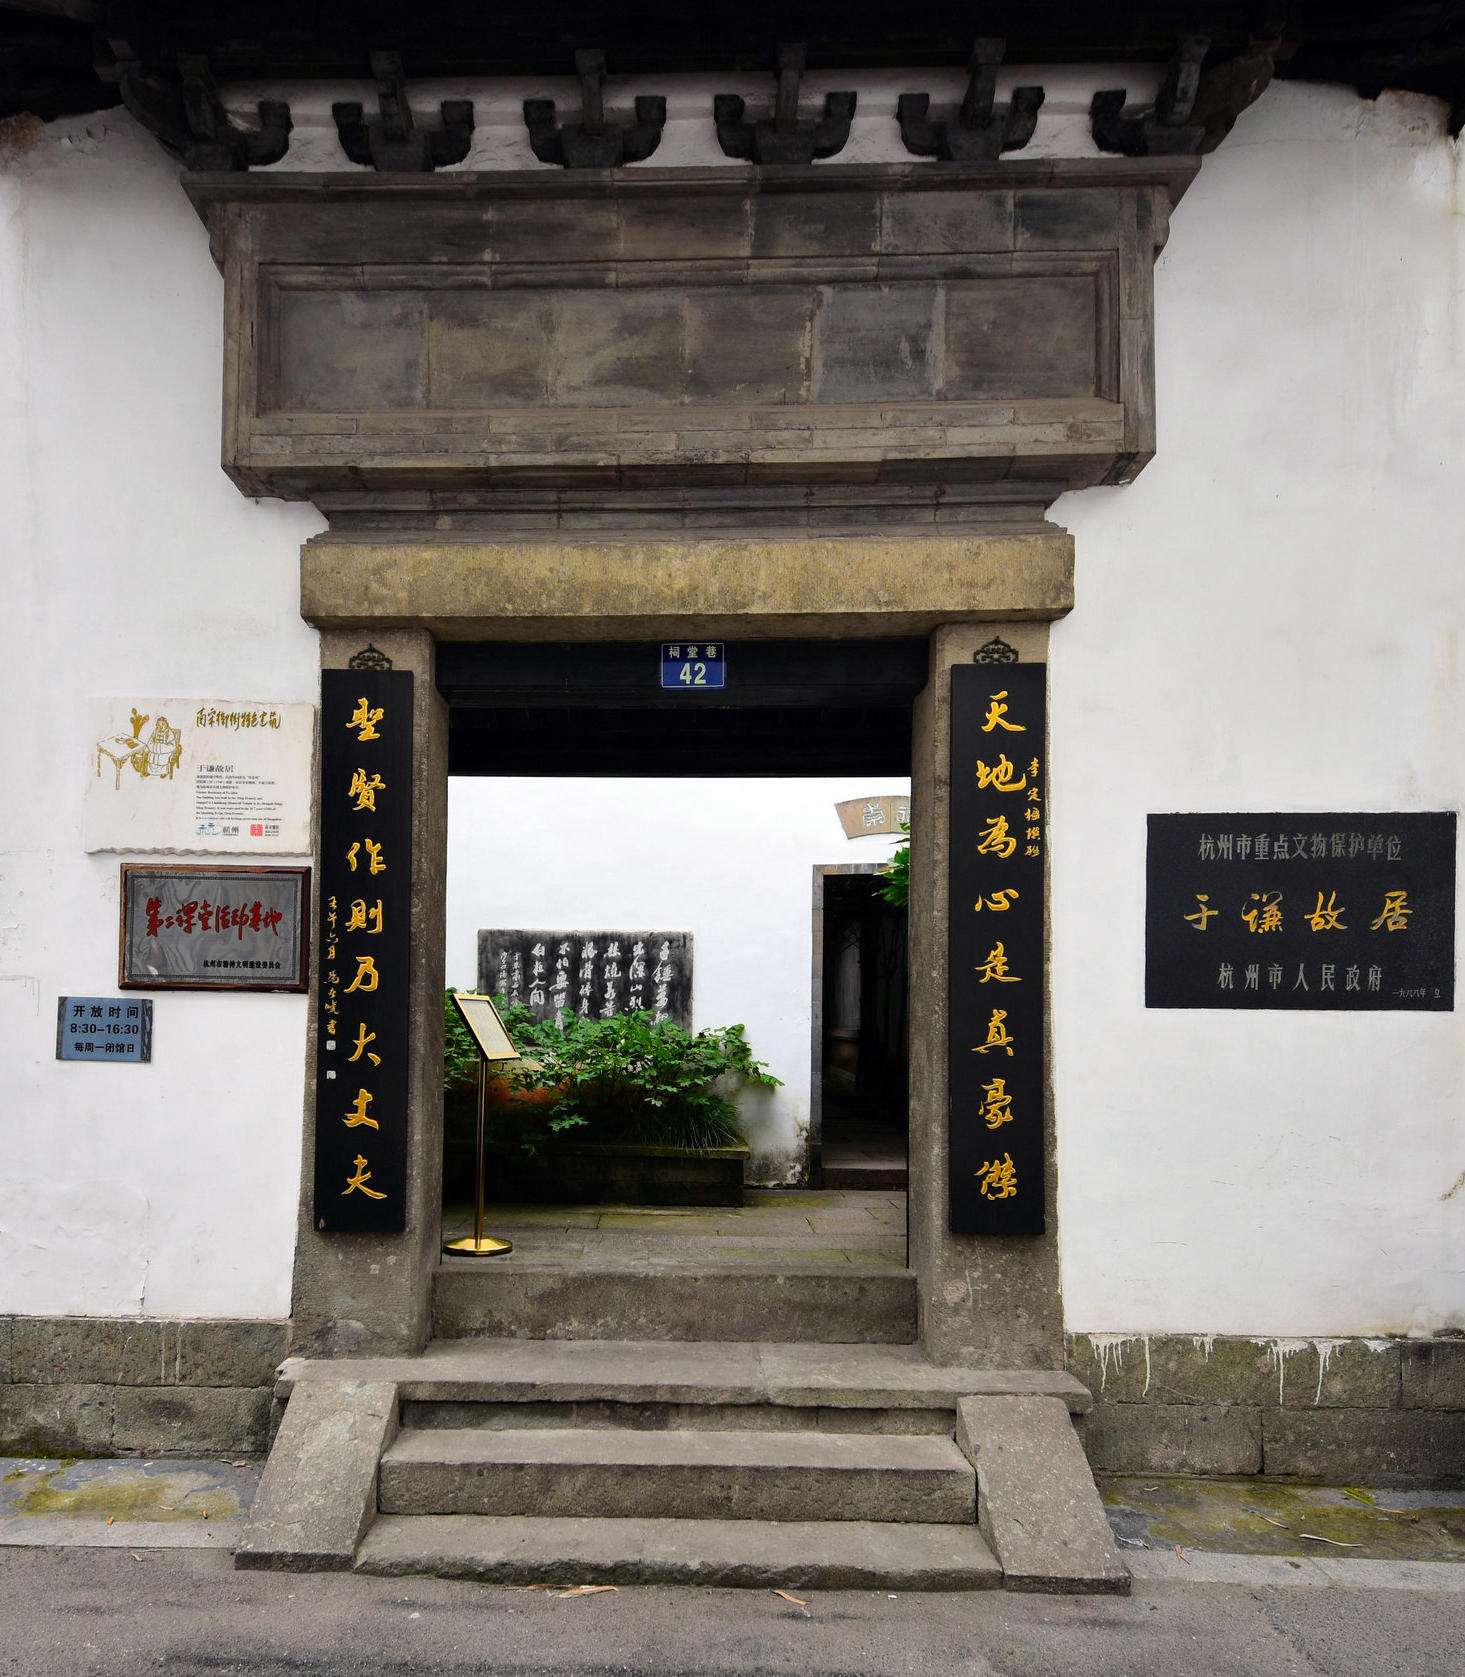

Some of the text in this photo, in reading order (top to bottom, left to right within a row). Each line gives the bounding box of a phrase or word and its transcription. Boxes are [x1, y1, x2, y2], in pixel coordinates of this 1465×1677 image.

[668, 645, 717, 659] 祠堂巷
[679, 662, 707, 685] 42
[1198, 832, 1402, 861] 杭州市重点文物保护单位
[203, 959, 281, 970] 杭州市精神文明建设委员会
[1216, 962, 1383, 992] 杭州市人民政府
[1392, 987, 1426, 998] 一九八八年
[73, 1005, 139, 1019] 开放时间
[70, 1023, 139, 1036] 8:30-16:30
[74, 1042, 135, 1054] 每周一闭馆日
